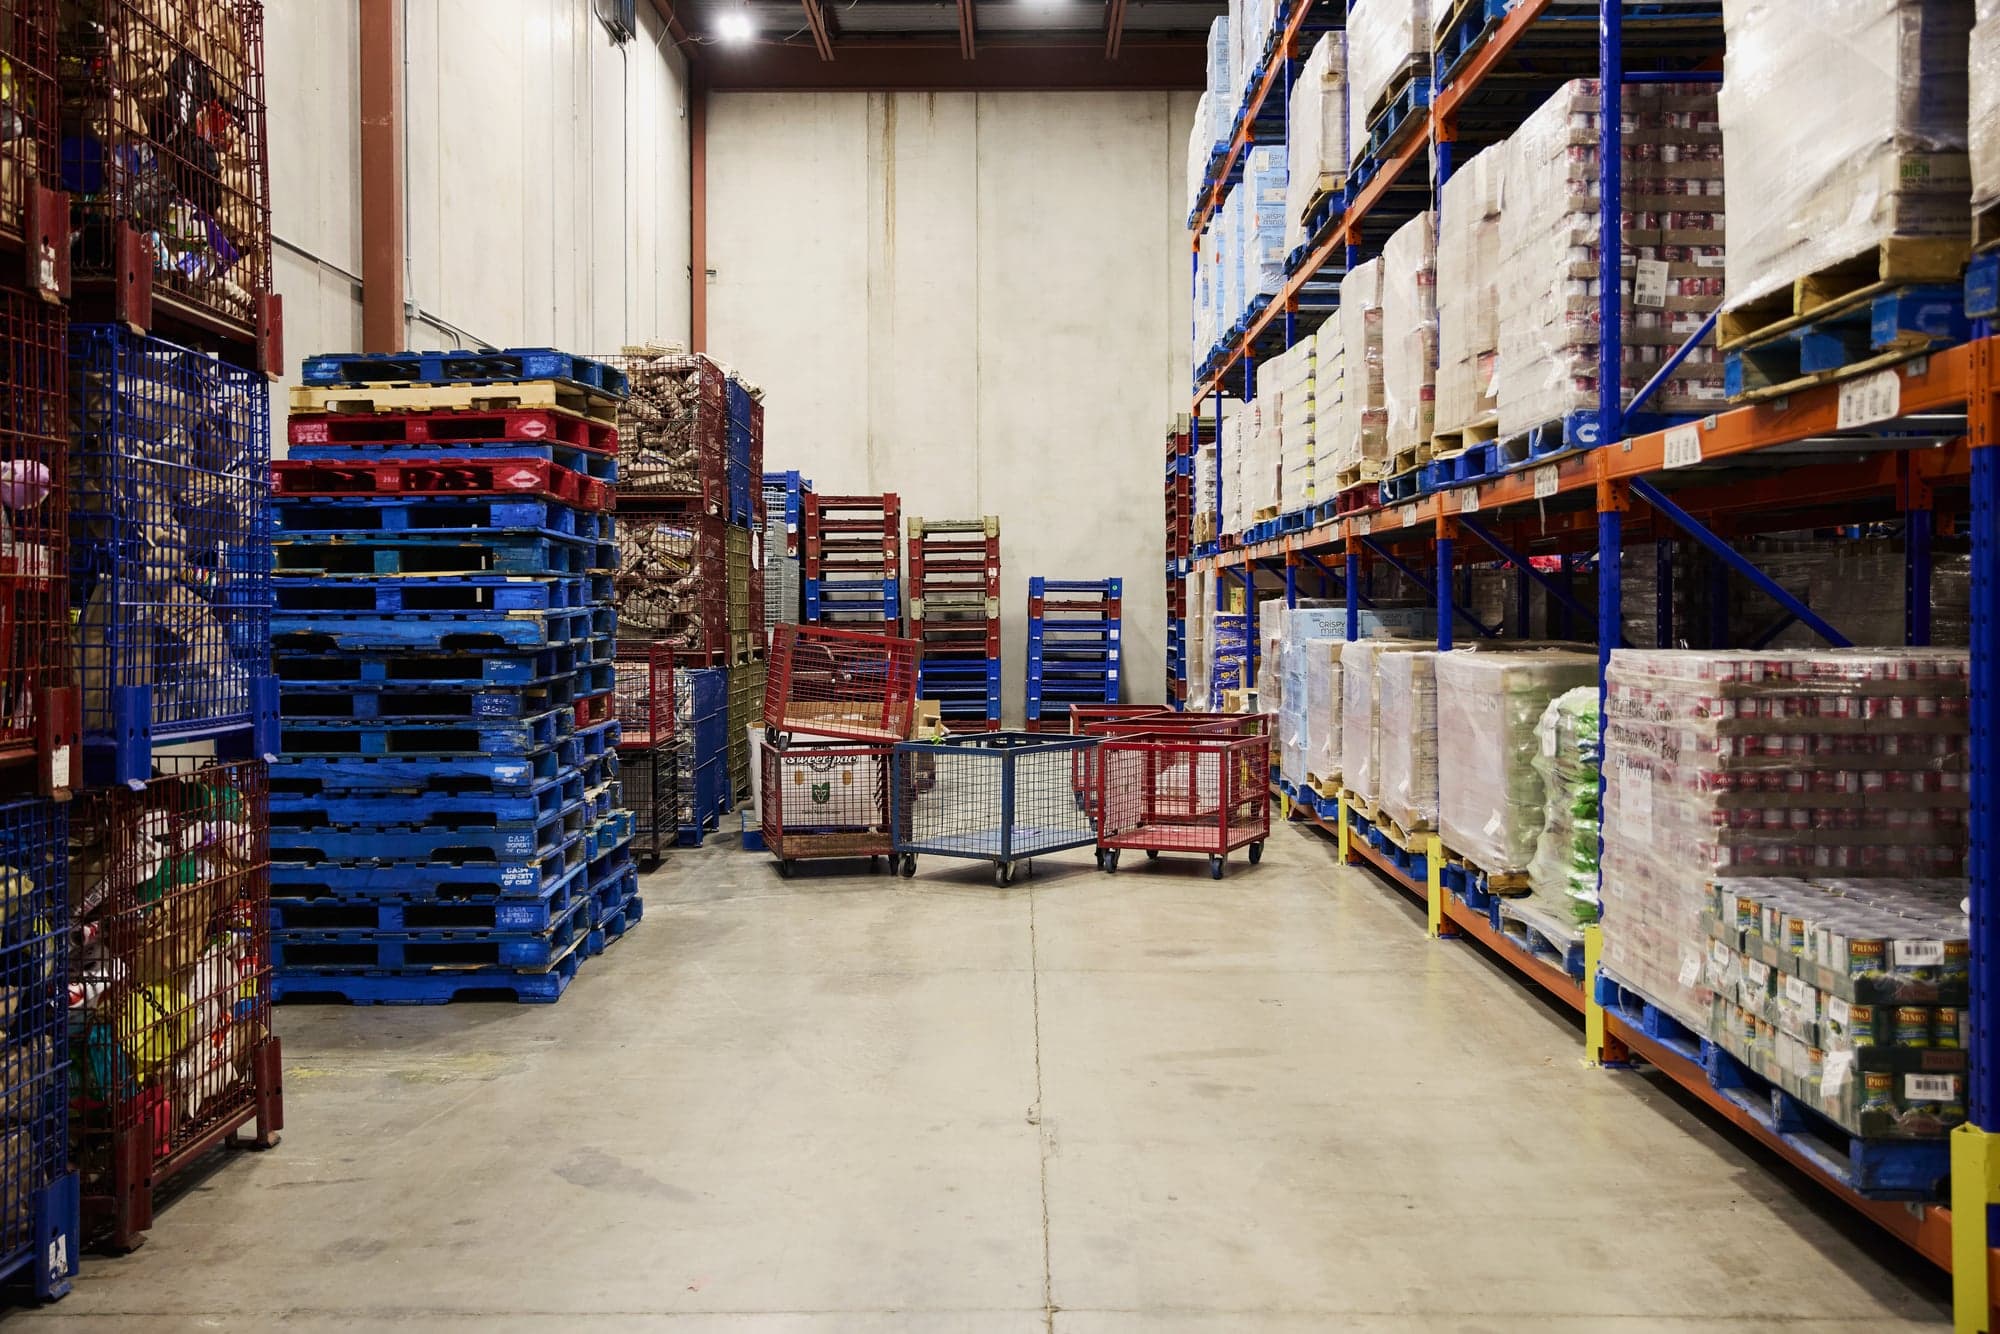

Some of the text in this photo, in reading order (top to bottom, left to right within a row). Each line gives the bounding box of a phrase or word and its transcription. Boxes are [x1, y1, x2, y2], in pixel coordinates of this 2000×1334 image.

[1320, 628, 1345, 636] minis
[1851, 942, 1881, 953] PRIMO
[1849, 1007, 1869, 1018] IMO
[1896, 1009, 1926, 1022] PRIMO
